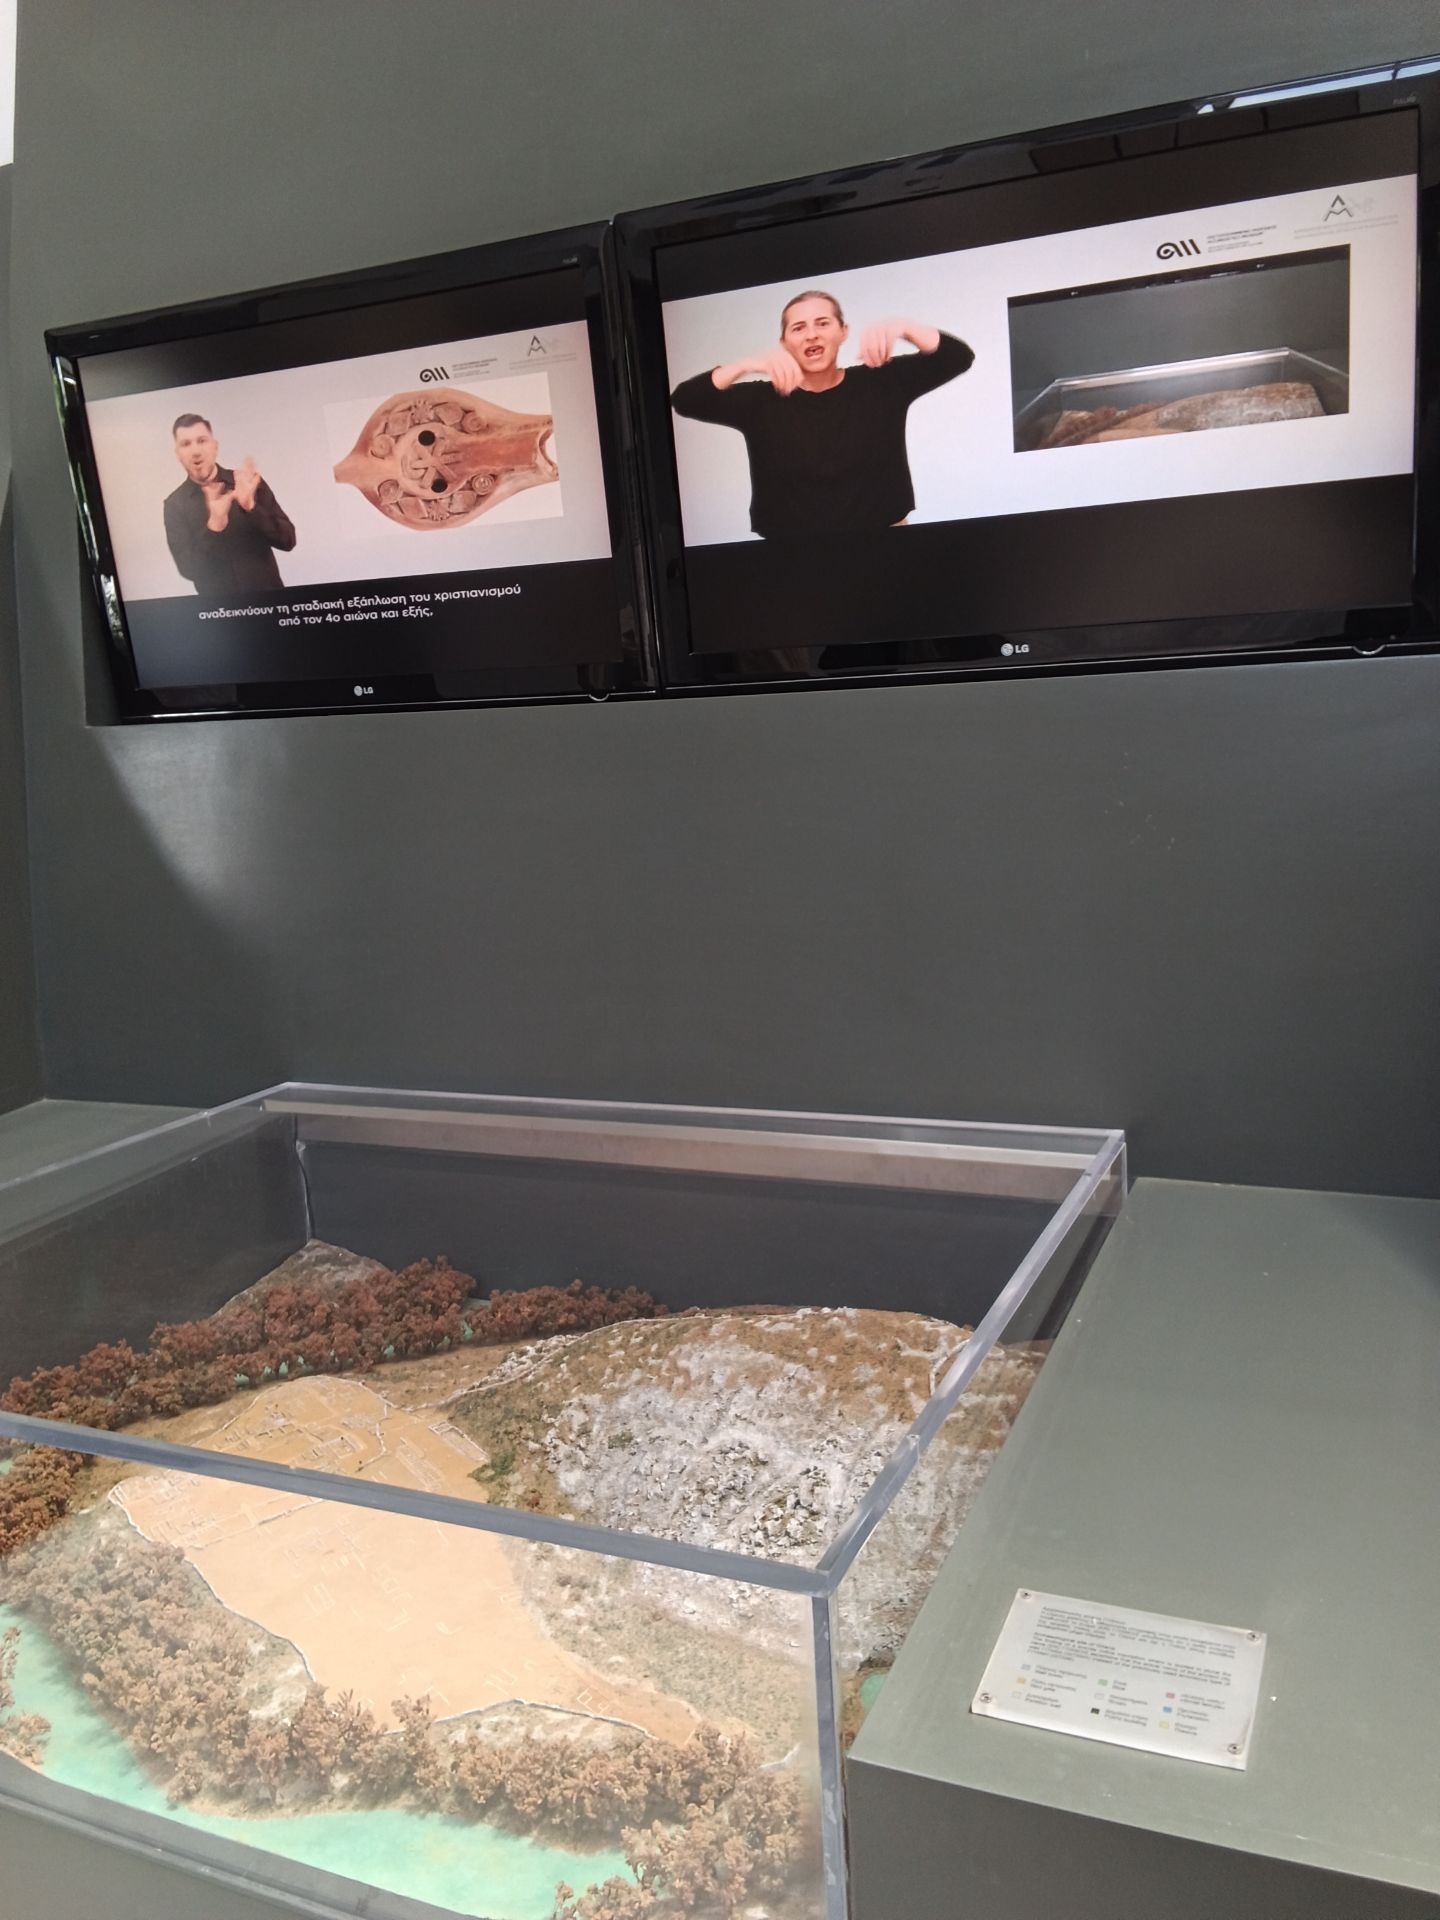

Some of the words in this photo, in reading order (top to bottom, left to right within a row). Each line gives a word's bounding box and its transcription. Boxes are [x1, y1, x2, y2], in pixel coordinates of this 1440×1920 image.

[198, 606, 274, 620] αναδεικνύουν
[276, 604, 290, 615] τη
[292, 598, 345, 612] σταδιακή
[347, 595, 407, 609] εξάπλωση
[409, 593, 431, 603] του
[434, 583, 522, 603] χριστιανισμού
[278, 617, 301, 627] από
[303, 616, 323, 625] τον
[343, 610, 378, 622] αιώνα
[381, 609, 399, 619] και
